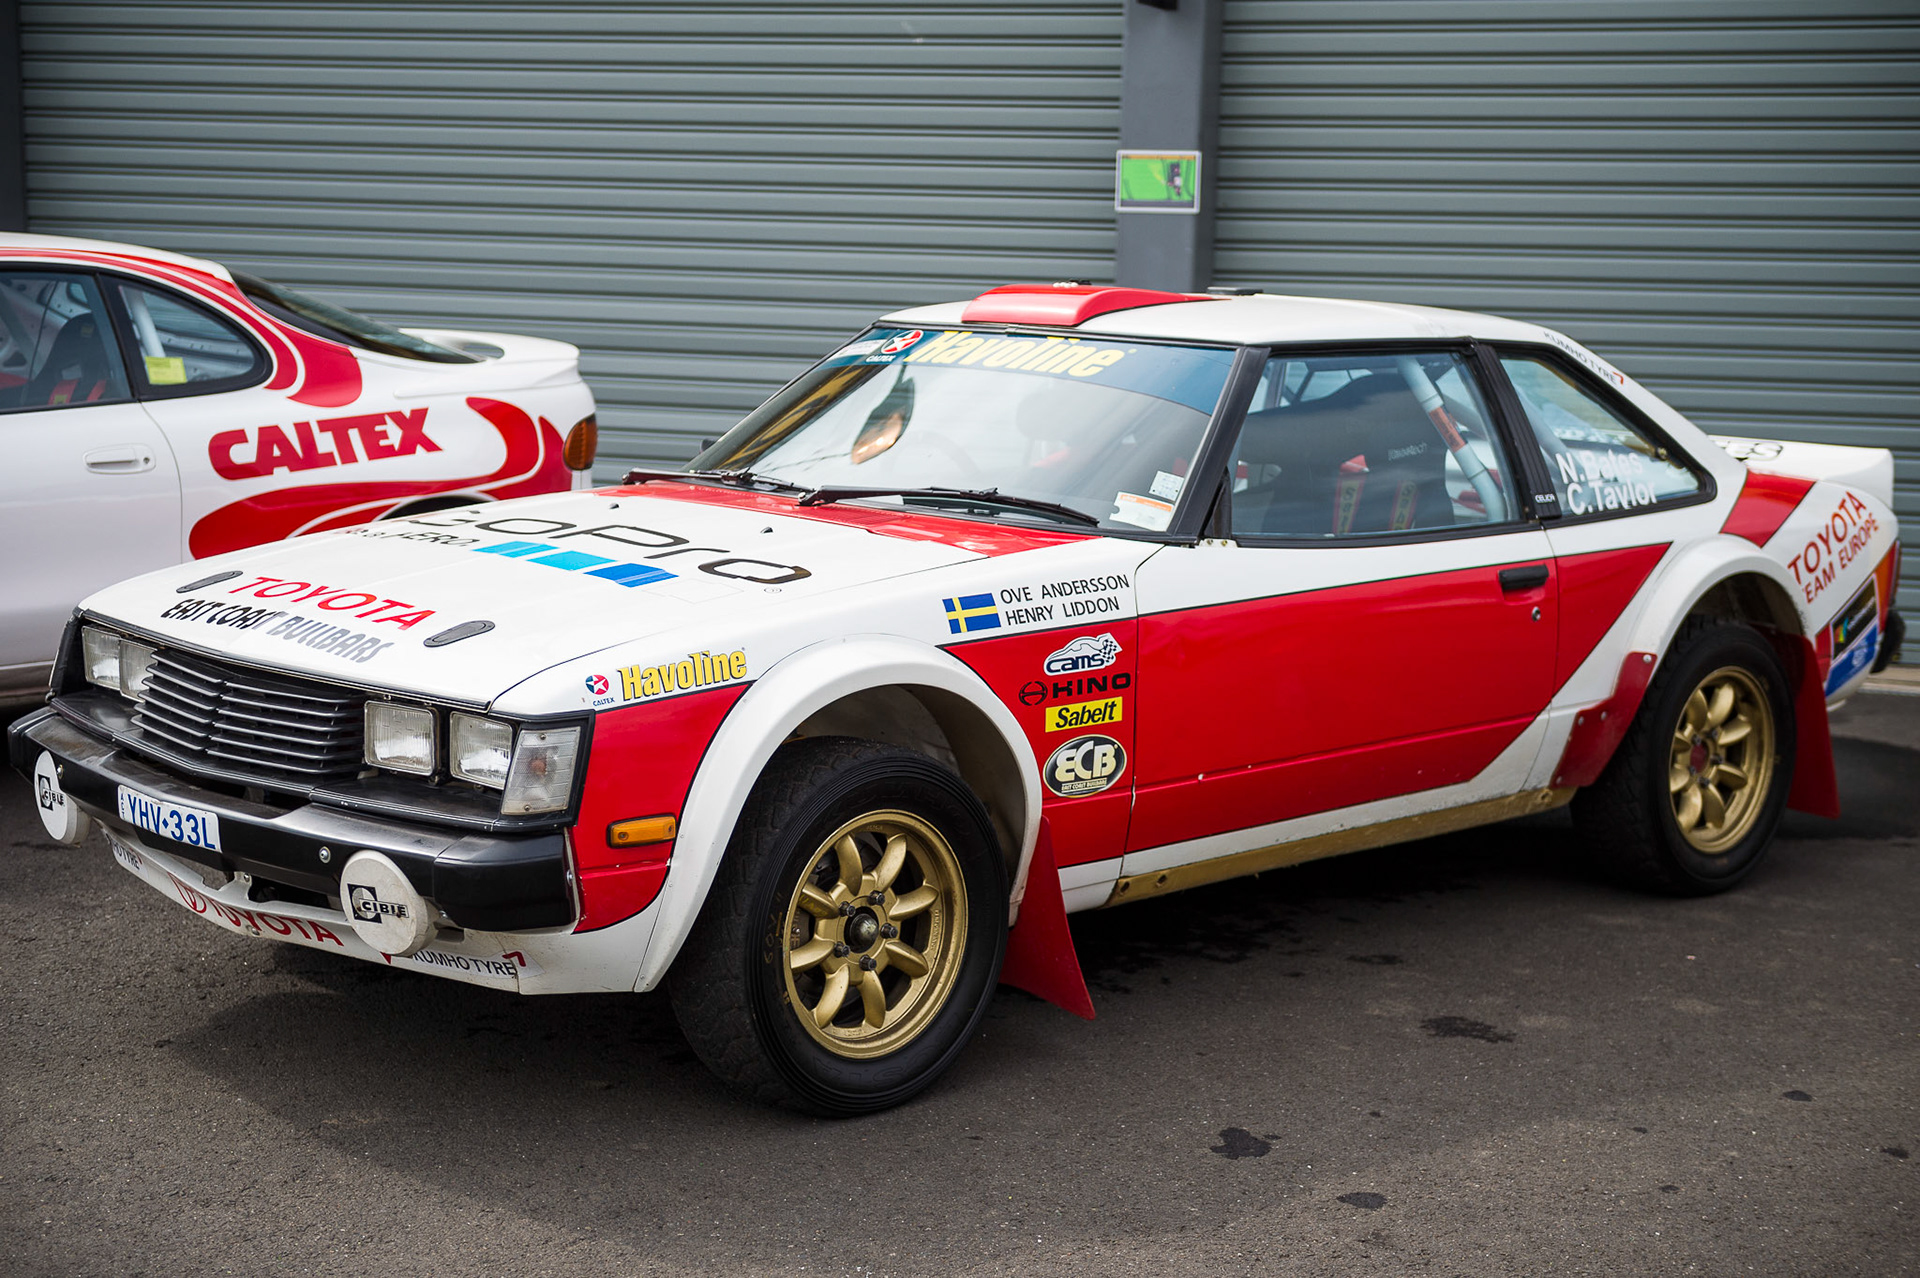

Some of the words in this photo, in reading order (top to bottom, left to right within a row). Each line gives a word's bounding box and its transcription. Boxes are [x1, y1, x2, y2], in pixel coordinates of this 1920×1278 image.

[903, 330, 1124, 377] Havoline
[208, 407, 443, 481] CALTEX
[1787, 490, 1867, 585] TOYOTA
[1804, 560, 1836, 605] EAM
[1838, 512, 1879, 570] EUROPE
[228, 576, 436, 631] TOYOTA
[1000, 586, 1033, 604] OVE
[1041, 574, 1130, 600] ANDERSSON
[160, 599, 226, 621] EAST
[206, 605, 289, 630] COAST
[266, 615, 395, 664] BULLBARS
[1005, 604, 1054, 626] HENRY
[1062, 595, 1120, 618] LIDDON
[617, 650, 747, 701] Havoline
[1052, 672, 1131, 699] HINO
[593, 697, 616, 706] CALTEX
[1055, 700, 1117, 729] Sabelt
[1055, 740, 1117, 782] ECB
[362, 901, 407, 917] CIBIE
[413, 950, 471, 970] KUMHO
[470, 960, 518, 976] TYRE
